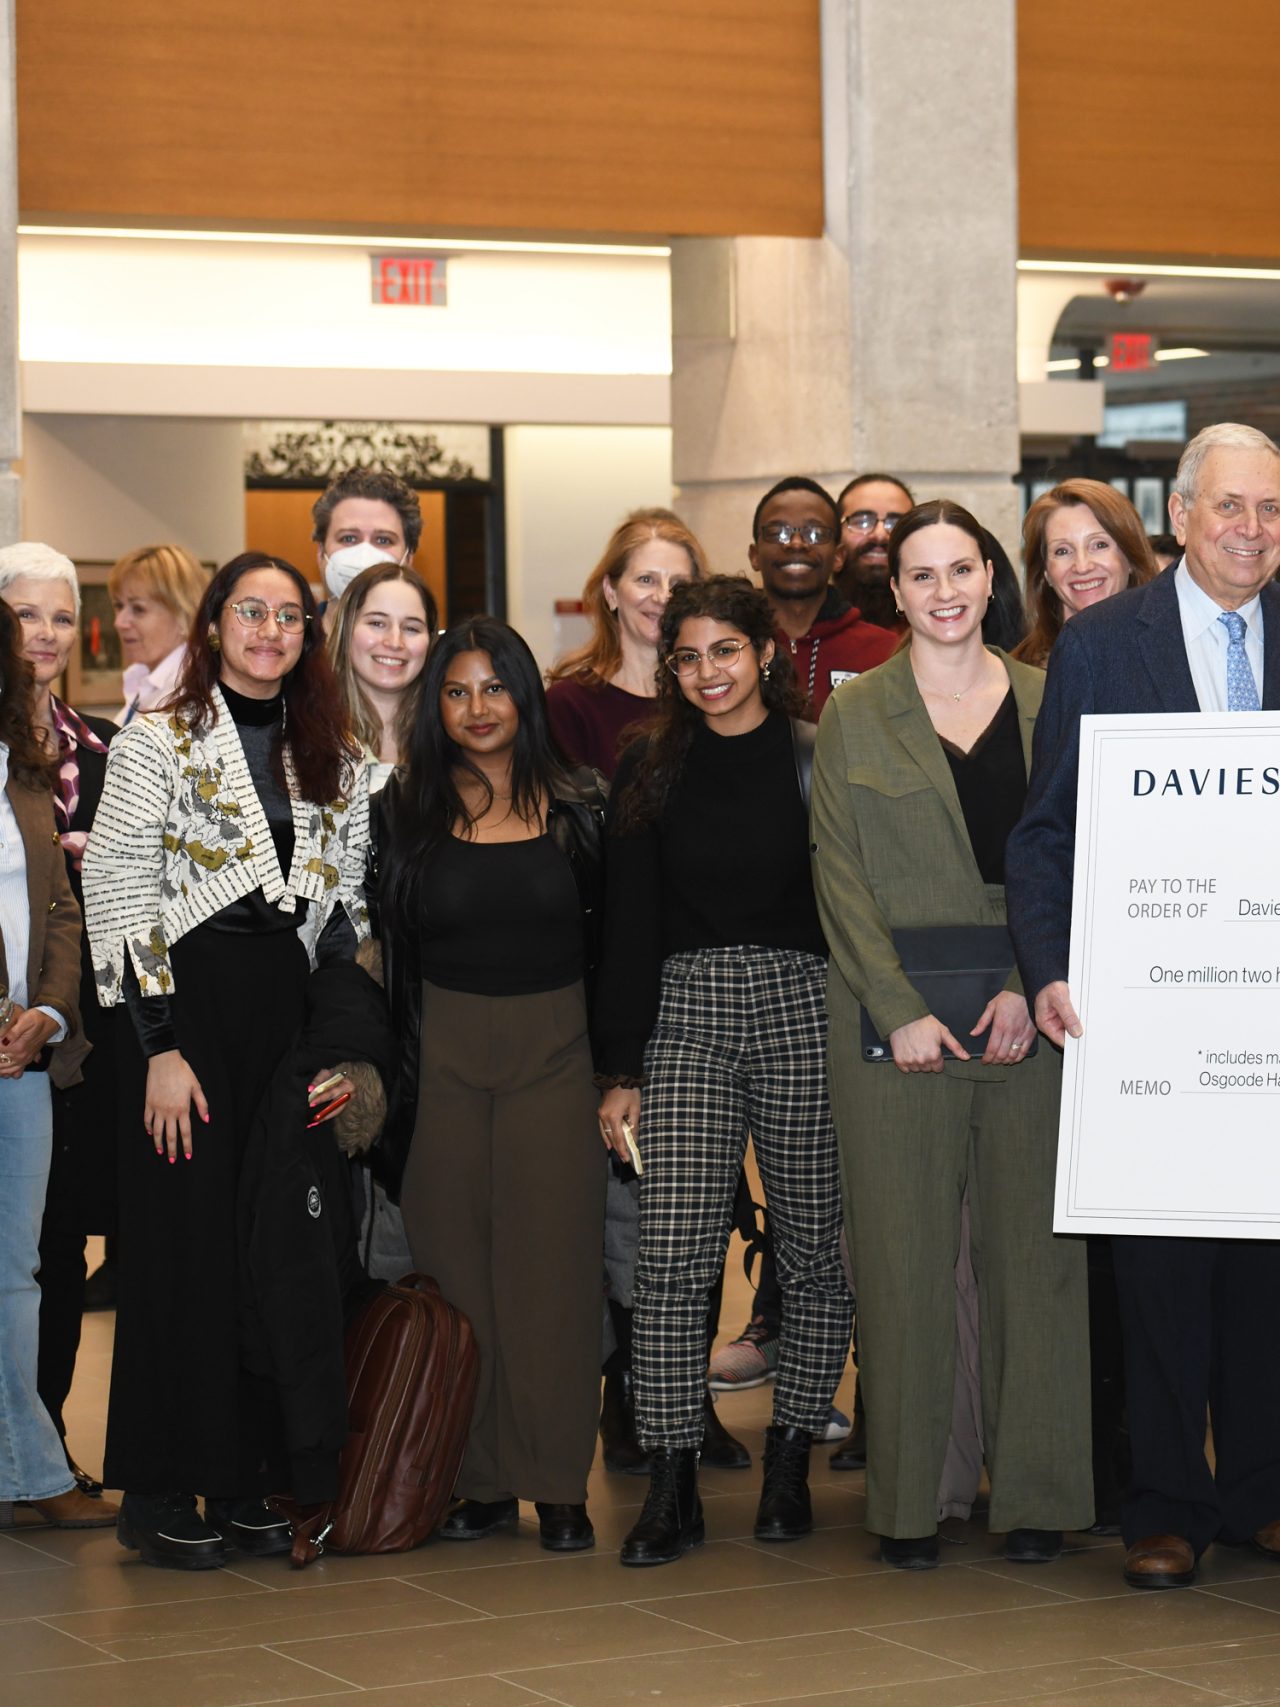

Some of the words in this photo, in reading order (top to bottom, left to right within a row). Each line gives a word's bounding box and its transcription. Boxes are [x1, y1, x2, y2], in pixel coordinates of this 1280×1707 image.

[380, 257, 436, 304] EXIT
[1132, 766, 1280, 797] DAVIES
[1129, 878, 1158, 894] PAY
[1161, 878, 1183, 894] TO
[1186, 878, 1217, 894] THE
[1127, 902, 1182, 919] ORDER
[1186, 902, 1209, 918] OF
[1149, 965, 1184, 984] One
[1187, 965, 1239, 984] million
[1242, 967, 1273, 984] two
[1205, 1049, 1263, 1066] includes
[1119, 1079, 1172, 1096] MEMO
[1198, 1070, 1264, 1090] Osgoode
